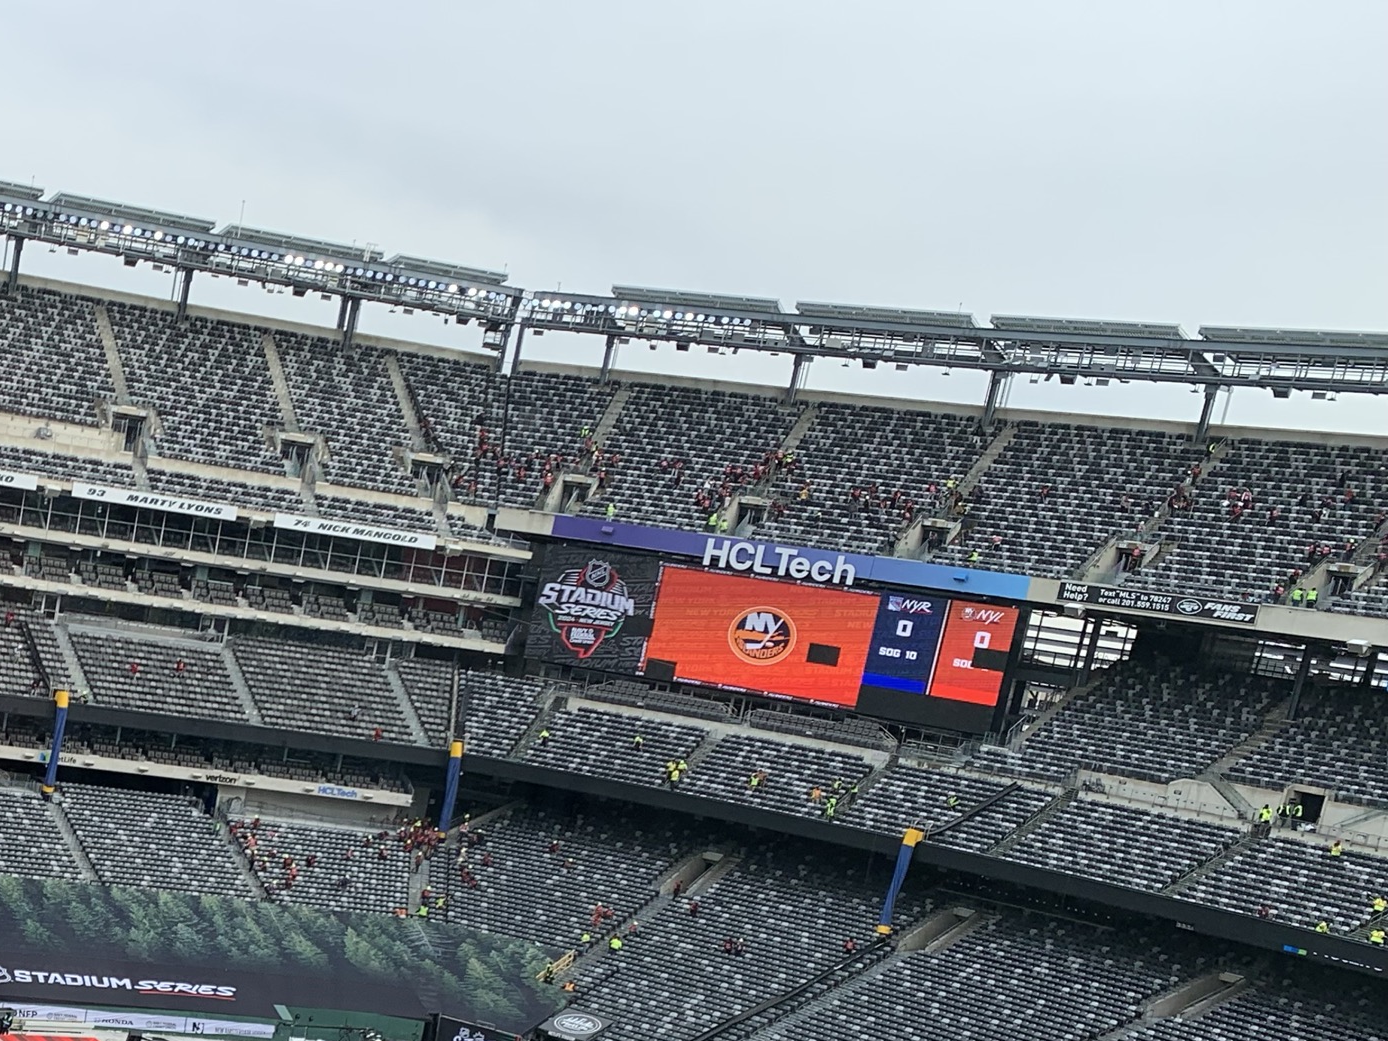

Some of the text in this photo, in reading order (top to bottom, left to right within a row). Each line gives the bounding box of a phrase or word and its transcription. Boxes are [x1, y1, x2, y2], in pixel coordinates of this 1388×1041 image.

[86, 487, 224, 516] 93 MARTY LYONS
[292, 519, 418, 544] 74 NICK MANGOLD
[702, 538, 856, 586] HCLTech
[1064, 583, 1088, 594] Need
[1100, 588, 1116, 597] Text
[538, 582, 634, 616] STADIUM
[1063, 590, 1089, 602] Help?
[1106, 597, 1121, 606] call
[554, 603, 624, 621] SERIES
[902, 599, 933, 614] NYR
[1204, 602, 1242, 613] FANS
[744, 612, 777, 634] NY
[1212, 611, 1255, 622] FIRST
[896, 619, 914, 637] 0
[974, 631, 992, 649] 0
[878, 647, 918, 660] SOG 10
[205, 773, 237, 784] verizon
[317, 786, 358, 798] HCLTech
[13, 969, 237, 997] STADIUM SERIES
[18, 1009, 38, 1018] NFP
[102, 1018, 134, 1026] HONDA
